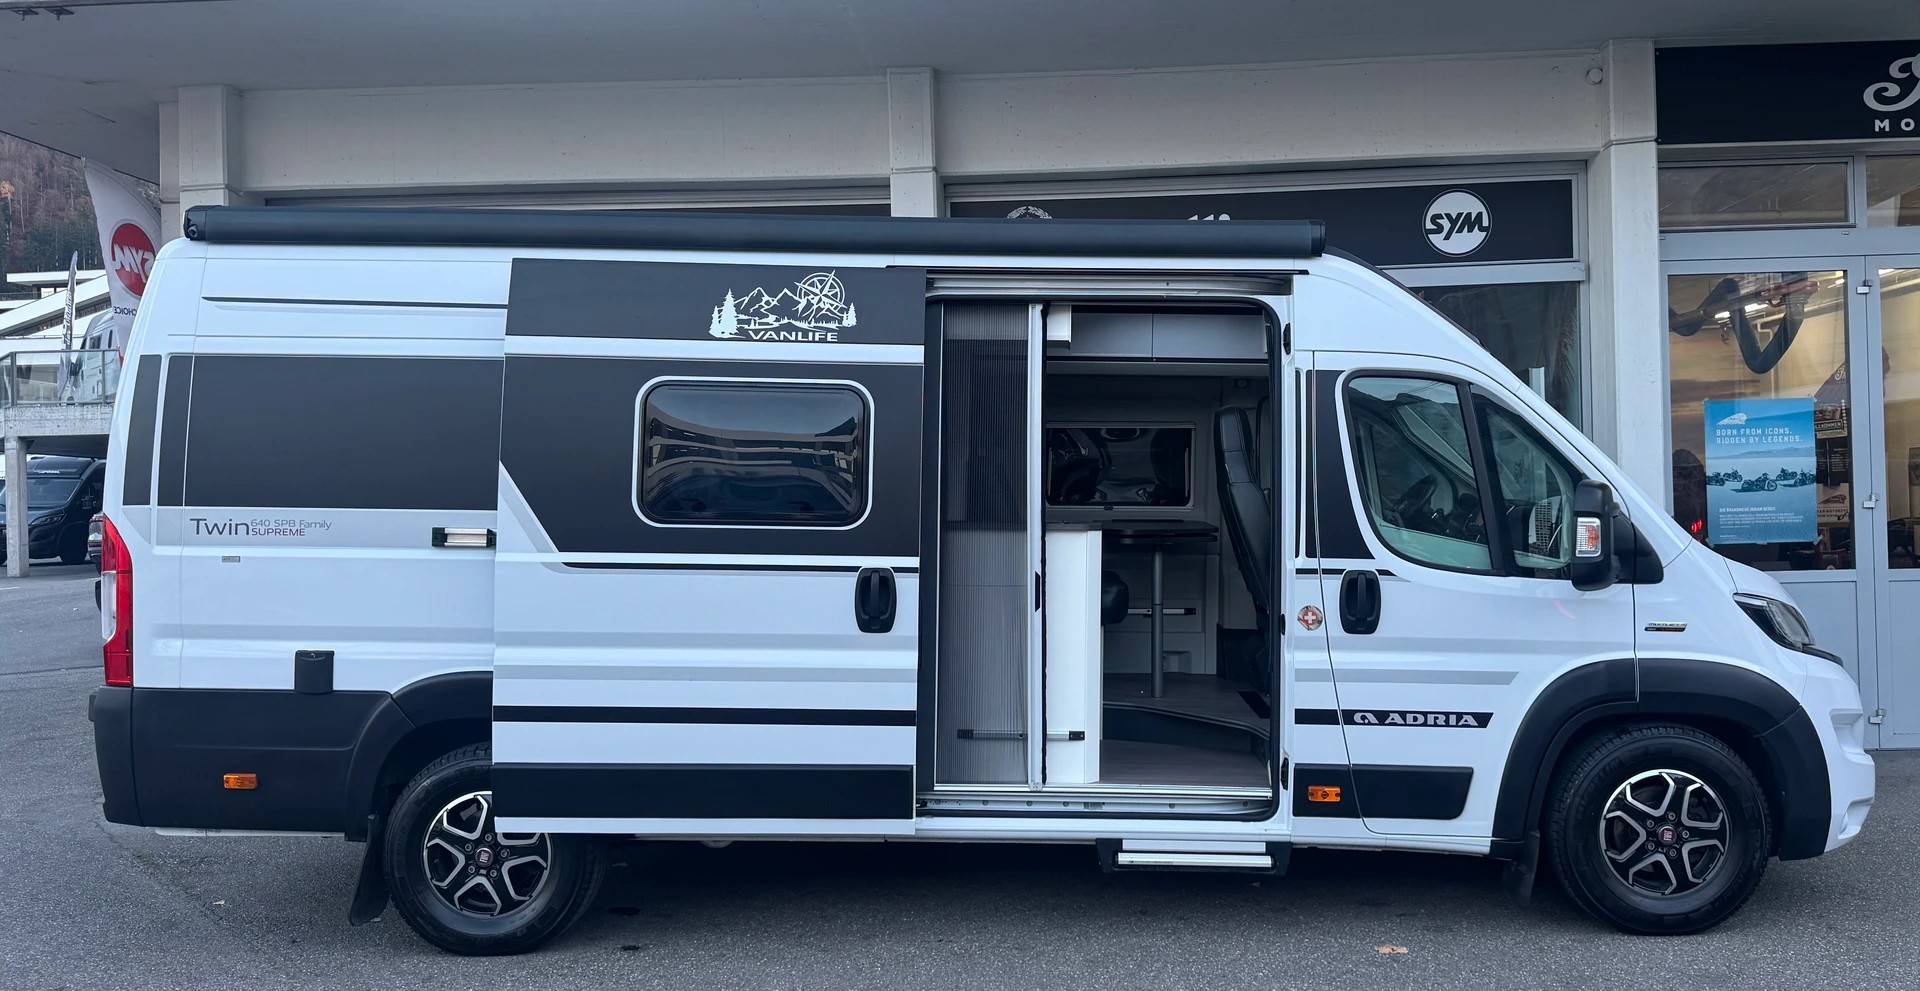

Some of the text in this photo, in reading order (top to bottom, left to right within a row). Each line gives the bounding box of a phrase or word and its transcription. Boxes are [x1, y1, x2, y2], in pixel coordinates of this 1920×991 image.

[1425, 211, 1490, 241] SYM
[748, 330, 838, 342] VANLIFE
[1765, 427, 1793, 435] ICONS.
[1762, 435, 1803, 443] LEGENDS.
[190, 518, 332, 536] Twin 640 SPB Family
[251, 528, 306, 537] SUPREME
[1384, 712, 1479, 726] ADRIA
